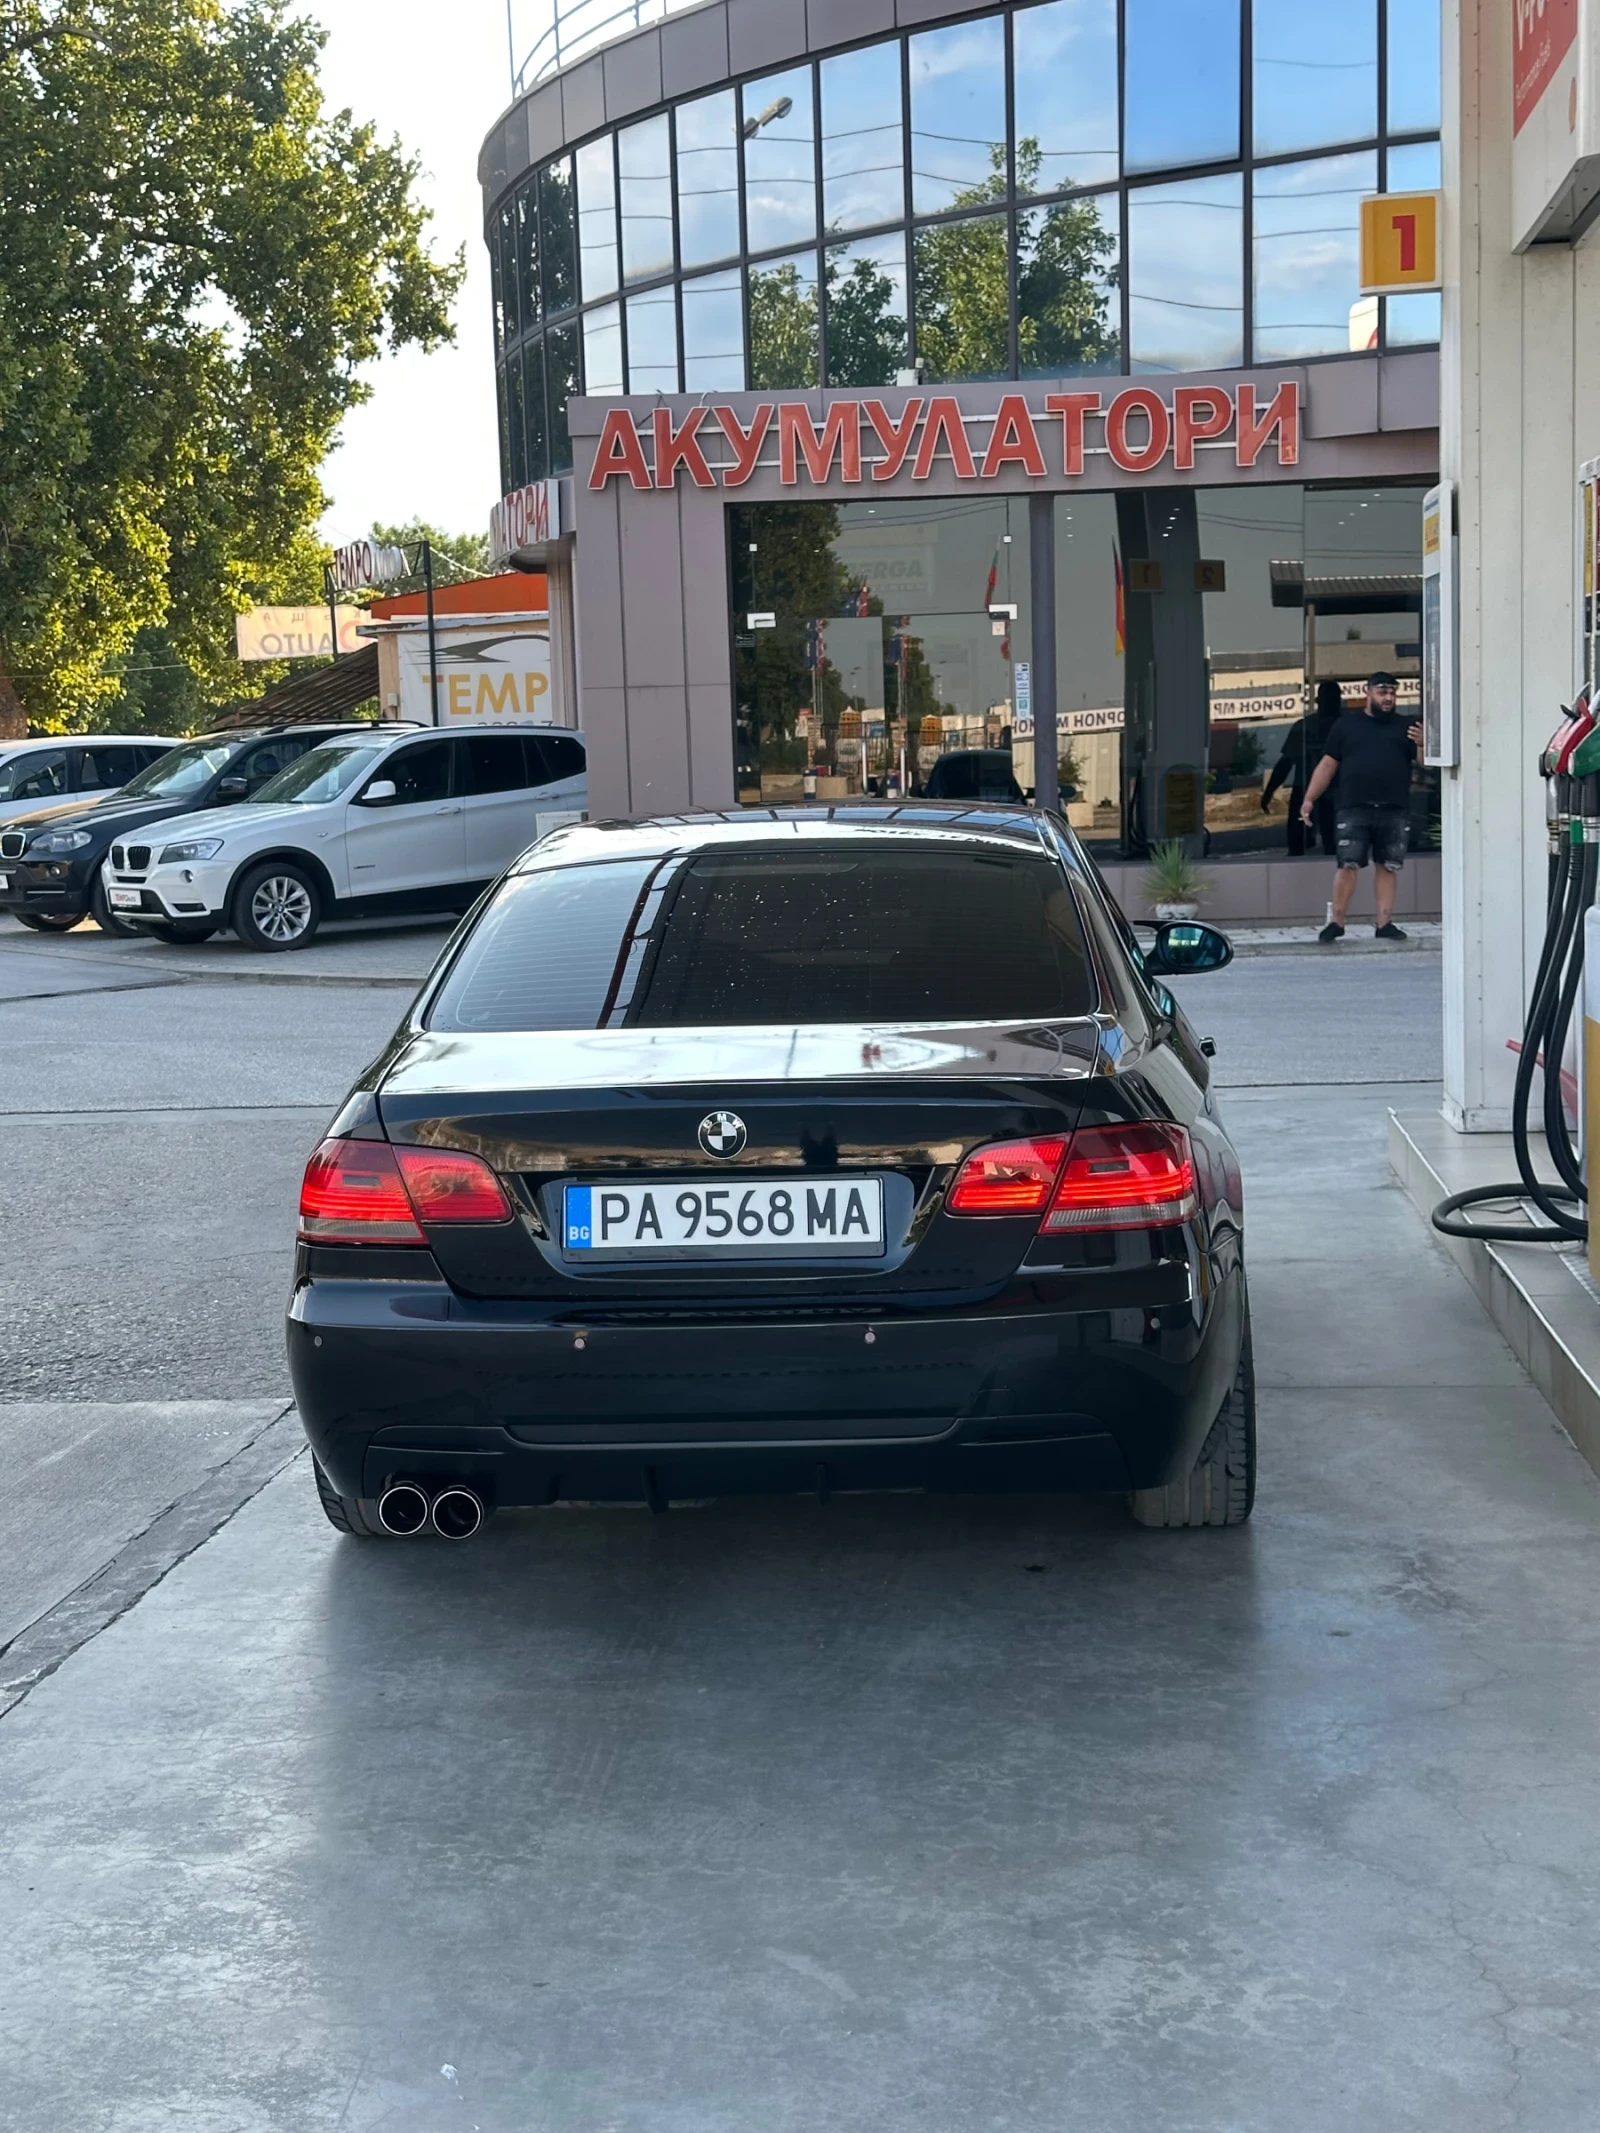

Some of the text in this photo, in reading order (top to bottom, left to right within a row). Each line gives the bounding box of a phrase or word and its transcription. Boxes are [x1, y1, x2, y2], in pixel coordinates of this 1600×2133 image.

[1392, 214, 1416, 271] 1
[588, 381, 1300, 490] АКУМУЛАТОРИ
[703, 1113, 743, 1129] BMW
[568, 1226, 590, 1241] BG
[601, 1187, 870, 1241] PA 9568 MA
